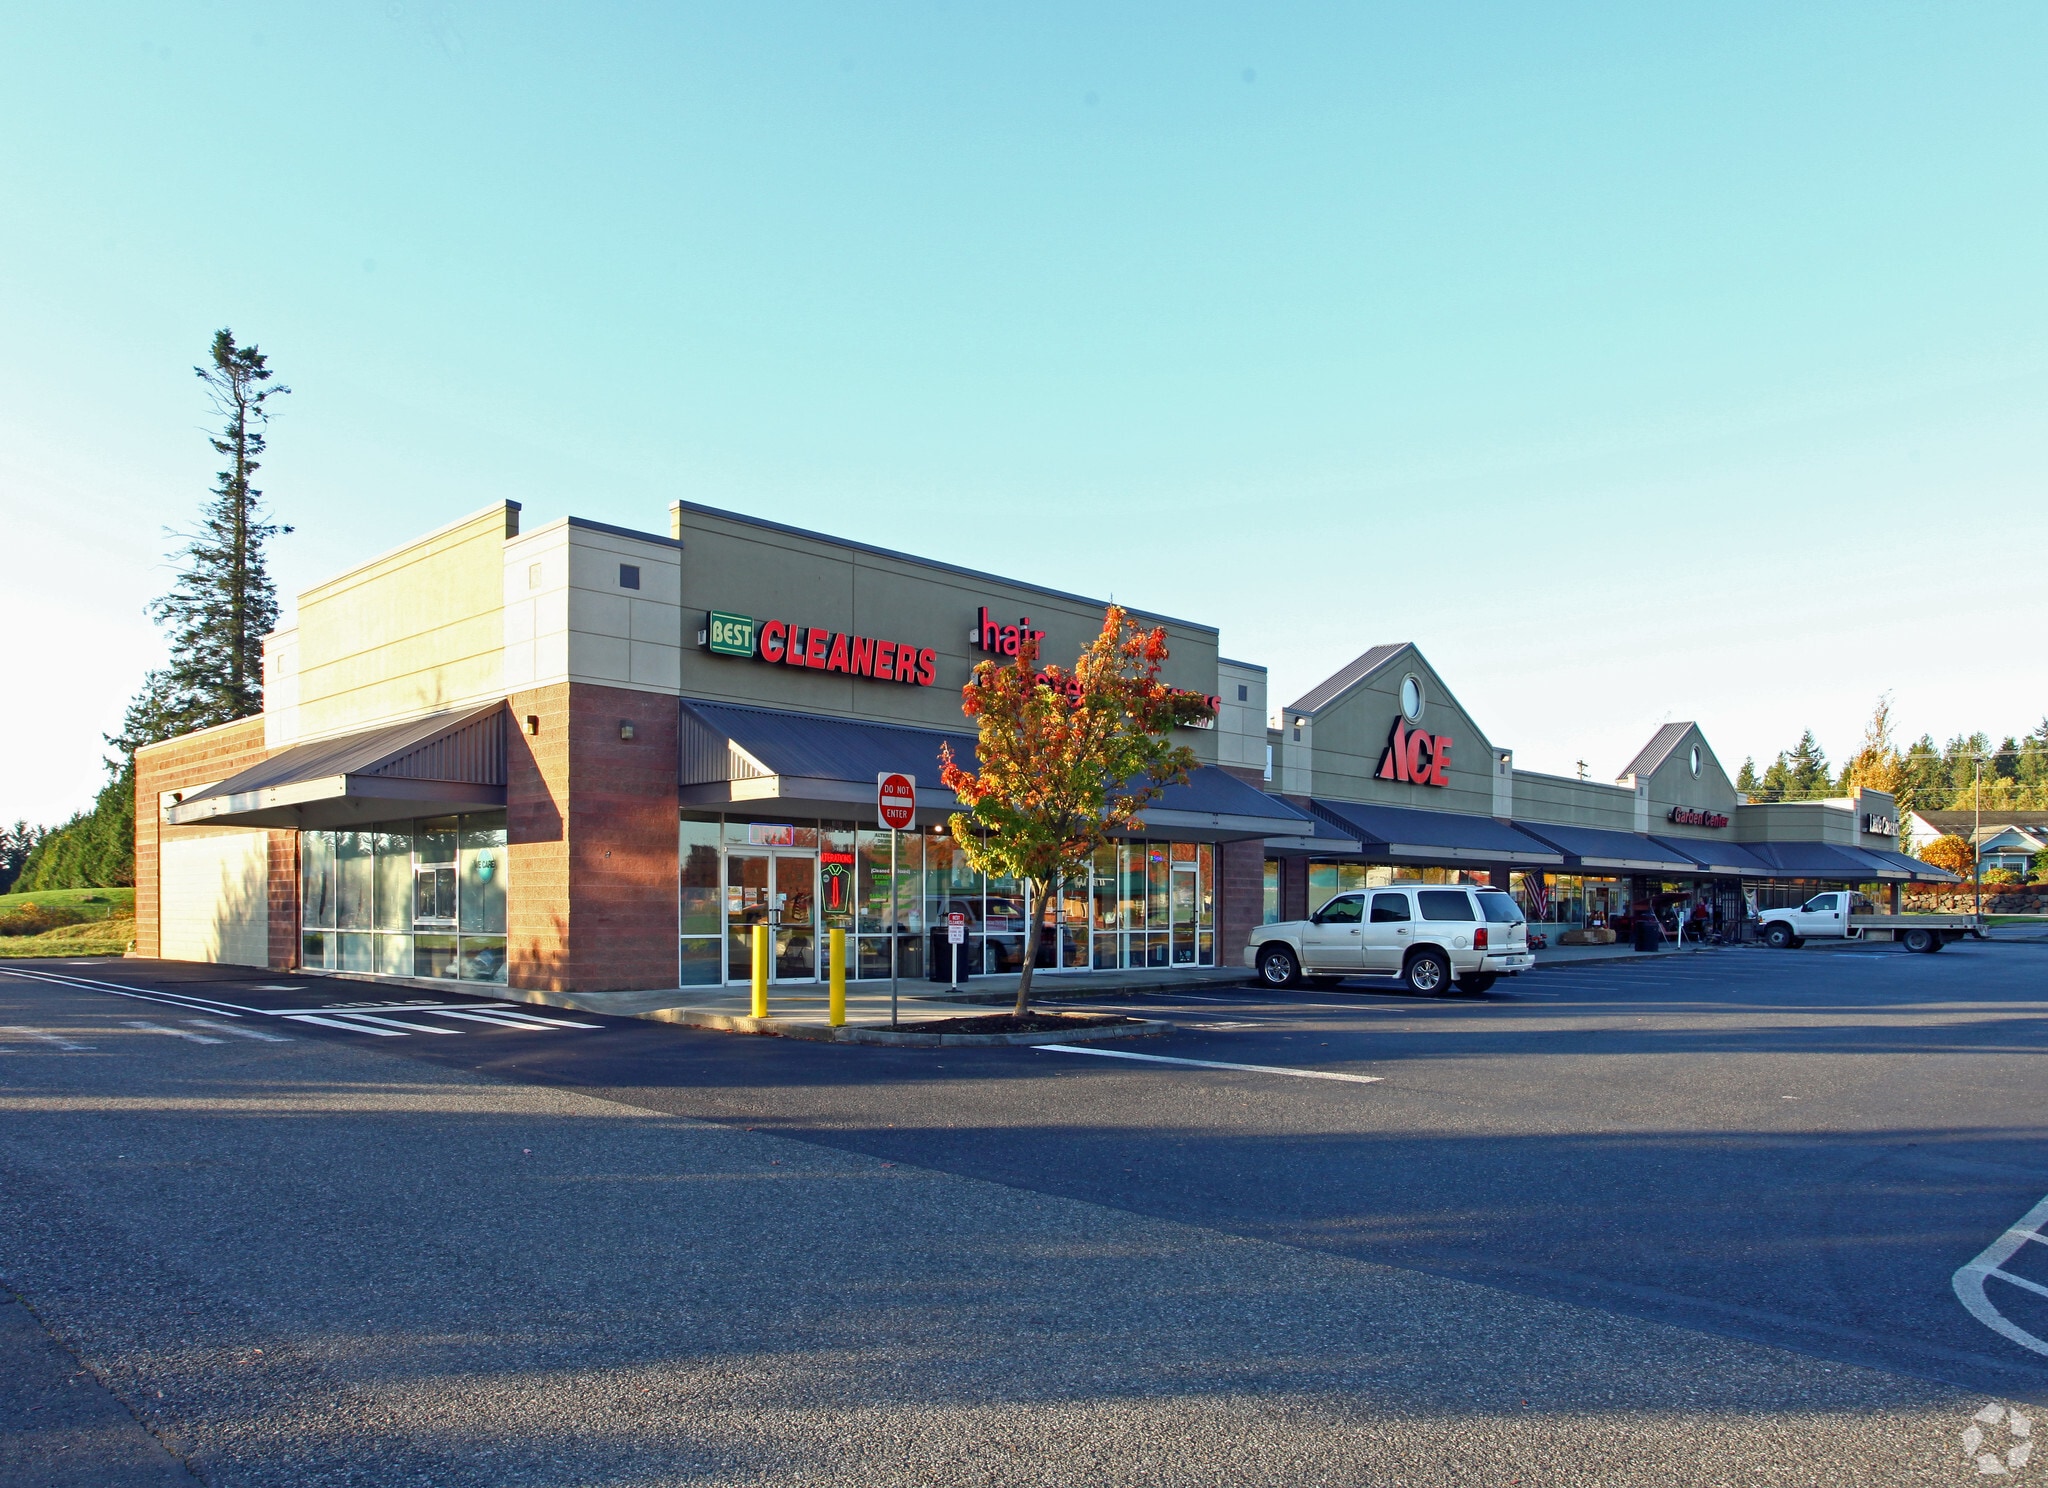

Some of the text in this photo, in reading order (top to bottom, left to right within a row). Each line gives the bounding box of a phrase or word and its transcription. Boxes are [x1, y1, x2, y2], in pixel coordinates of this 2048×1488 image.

[980, 606, 1046, 661] hair
[712, 619, 937, 687] BEST CLEANERS
[1376, 714, 1453, 787] ACE
[884, 785, 910, 795] DO NOT
[886, 809, 908, 819] ENTER
[1675, 806, 1730, 828] Garden Center
